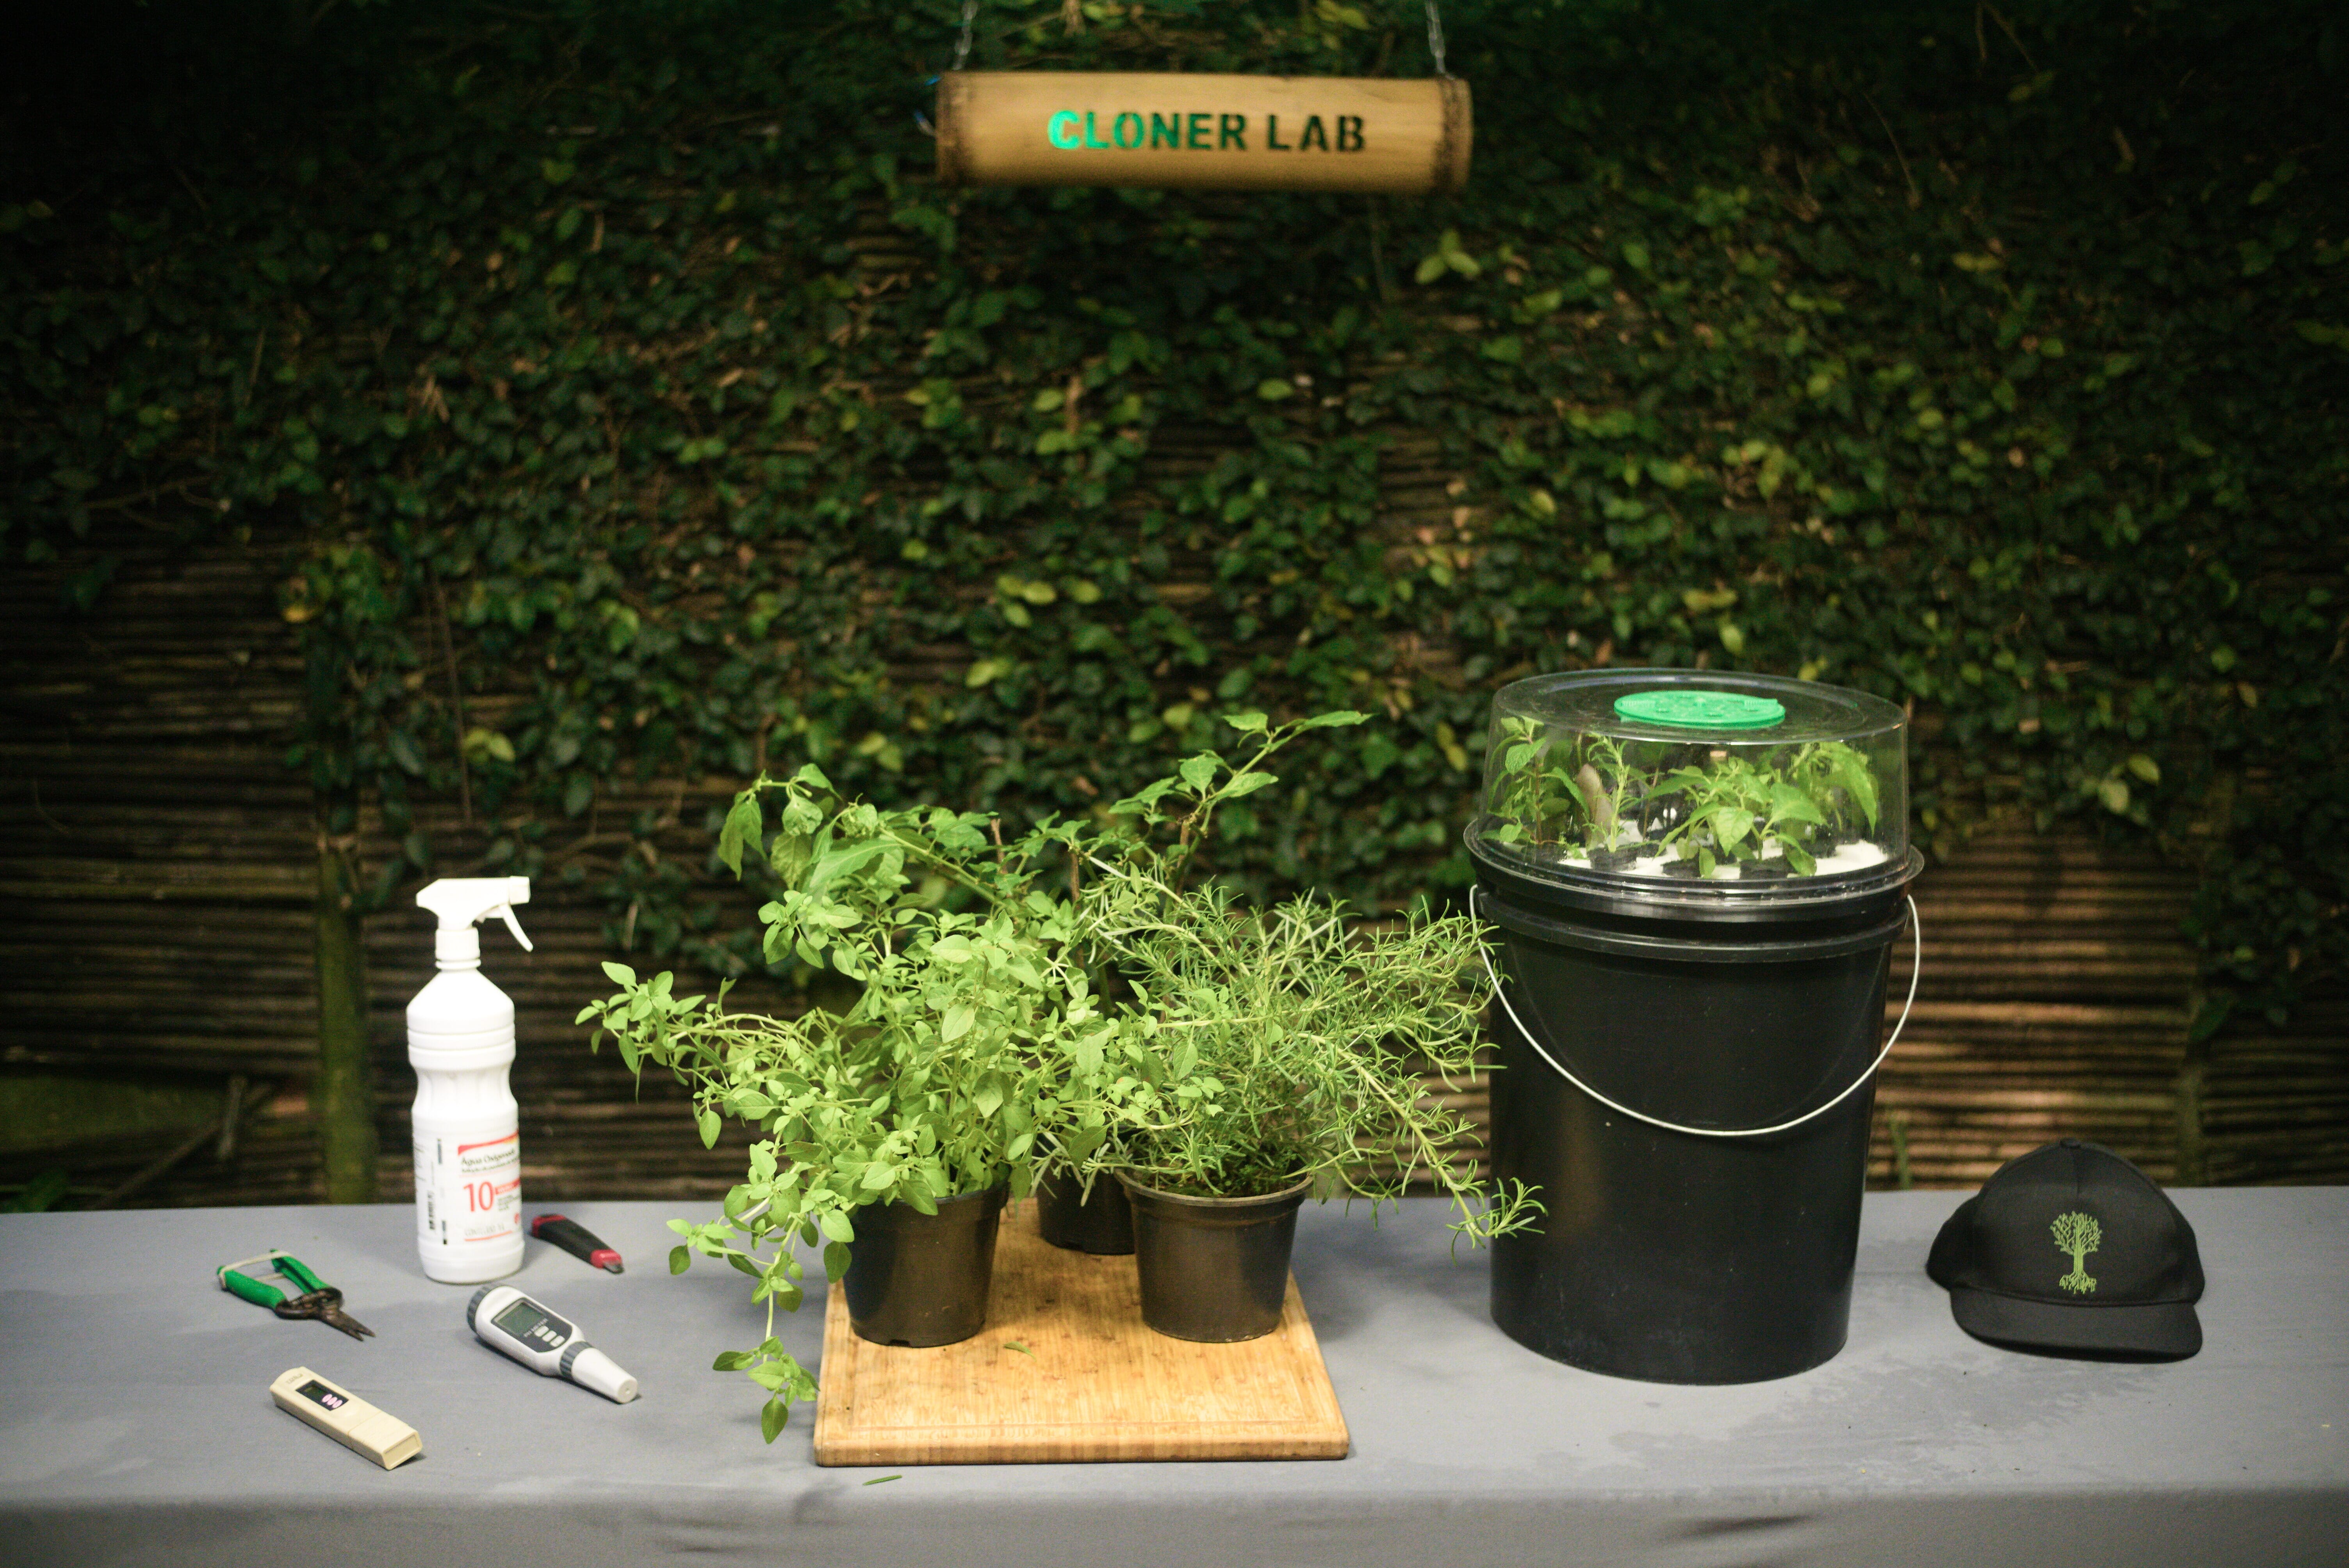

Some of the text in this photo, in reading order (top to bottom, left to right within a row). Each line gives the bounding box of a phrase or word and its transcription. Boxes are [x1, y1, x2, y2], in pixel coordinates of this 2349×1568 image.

[1047, 110, 1365, 151] CLONER LAB
[463, 1181, 494, 1212] 10
